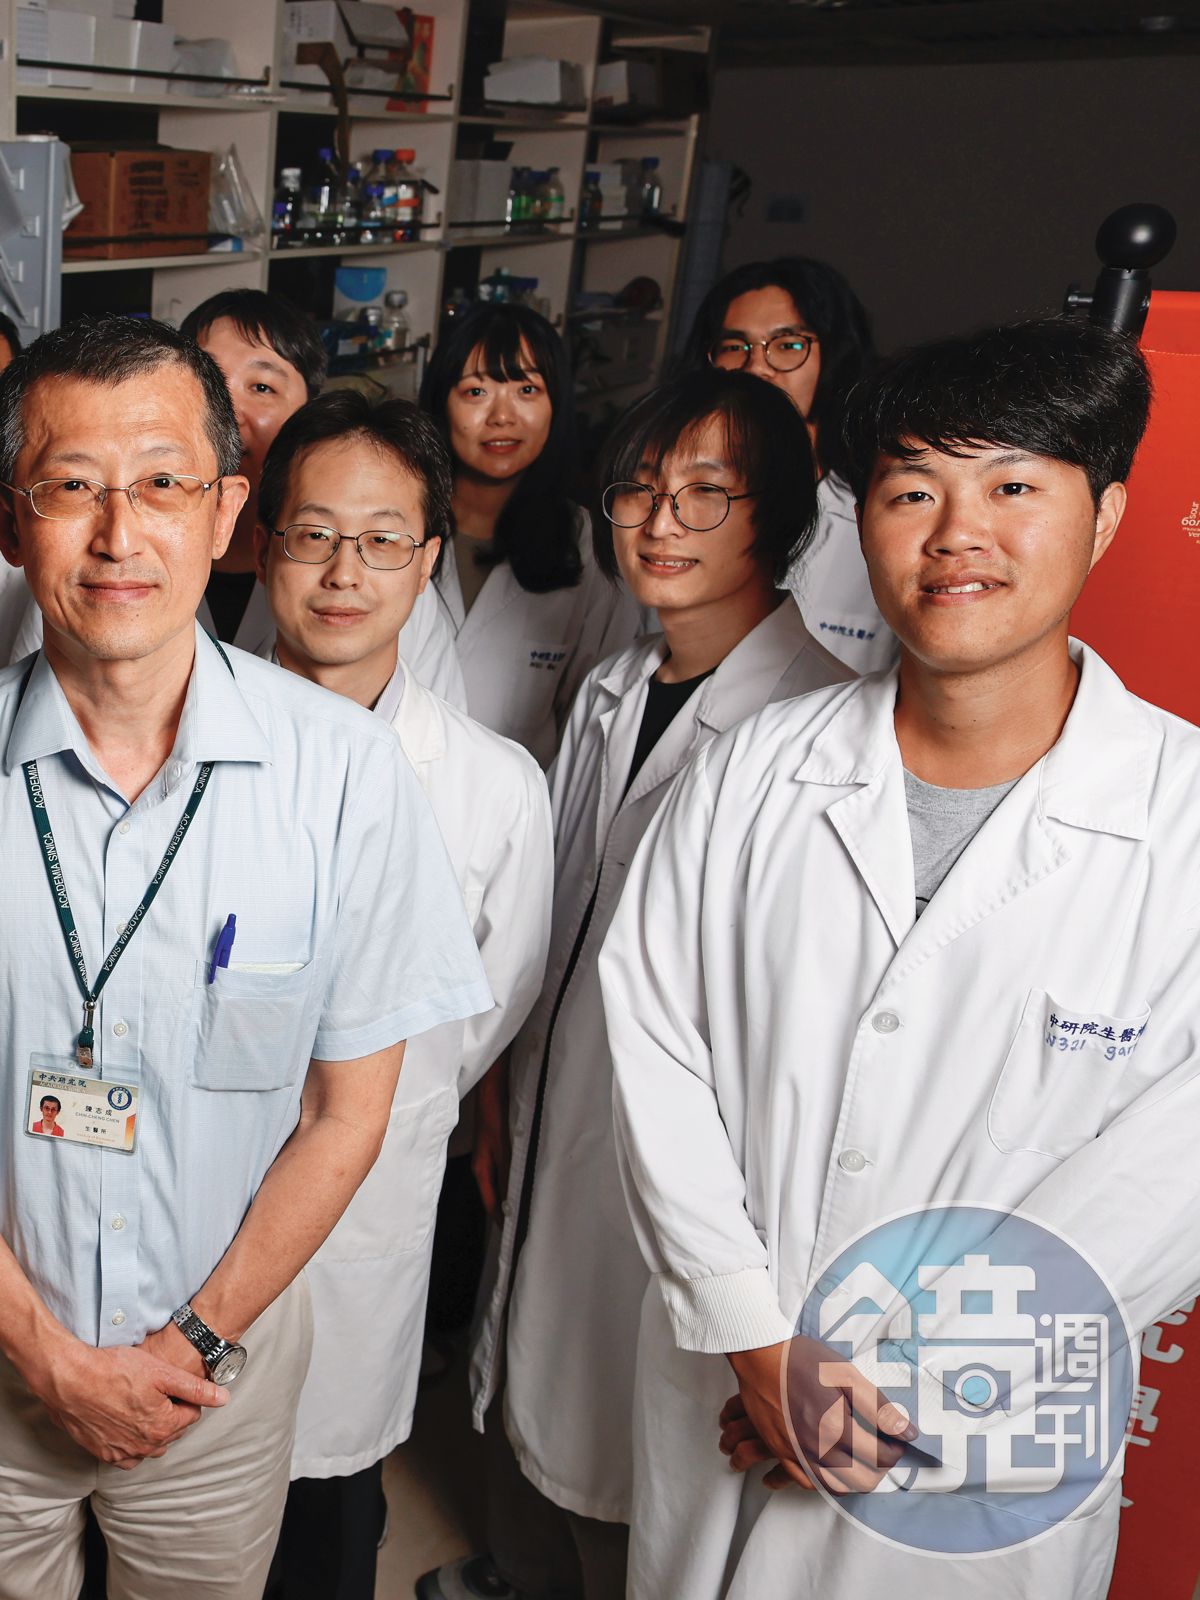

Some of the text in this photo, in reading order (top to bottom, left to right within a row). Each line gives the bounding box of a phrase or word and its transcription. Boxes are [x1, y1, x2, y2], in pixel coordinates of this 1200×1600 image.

[27, 763, 46, 808] ACADEMIA
[194, 766, 210, 793] SINICA
[43, 831, 70, 909] ACADEMIA SINICA
[152, 813, 191, 885] ACADEMIA SINICA
[69, 929, 83, 959] SINICA
[103, 903, 146, 971] ACADEMIA SINICA
[39, 1073, 87, 1088] 中央研究院
